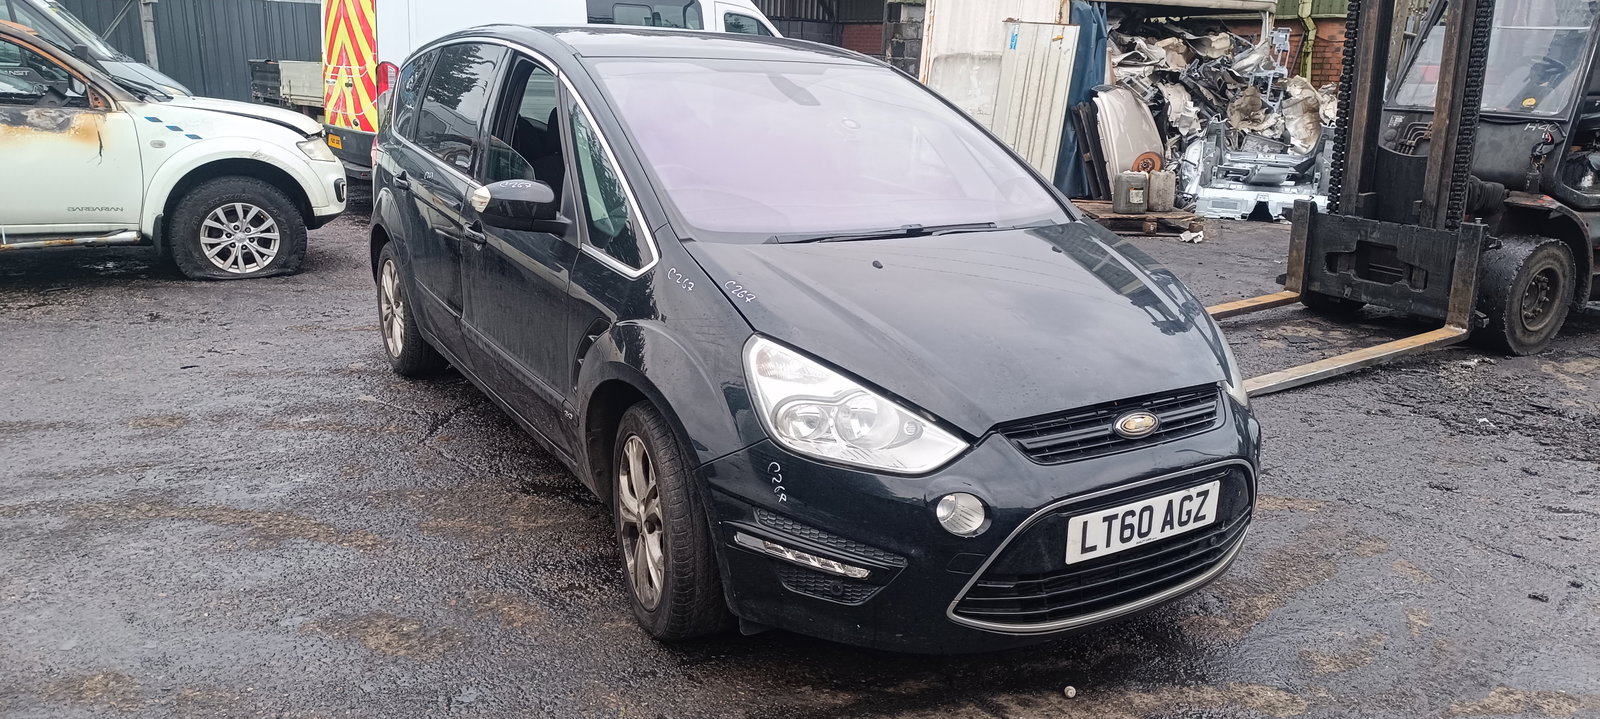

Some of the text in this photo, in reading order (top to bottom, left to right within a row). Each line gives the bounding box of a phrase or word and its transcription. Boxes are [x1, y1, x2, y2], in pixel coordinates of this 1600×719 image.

[667, 267, 695, 292] C267
[724, 280, 756, 303] C267
[767, 461, 788, 503] C267
[1080, 489, 1210, 555] LT60 AGZ
